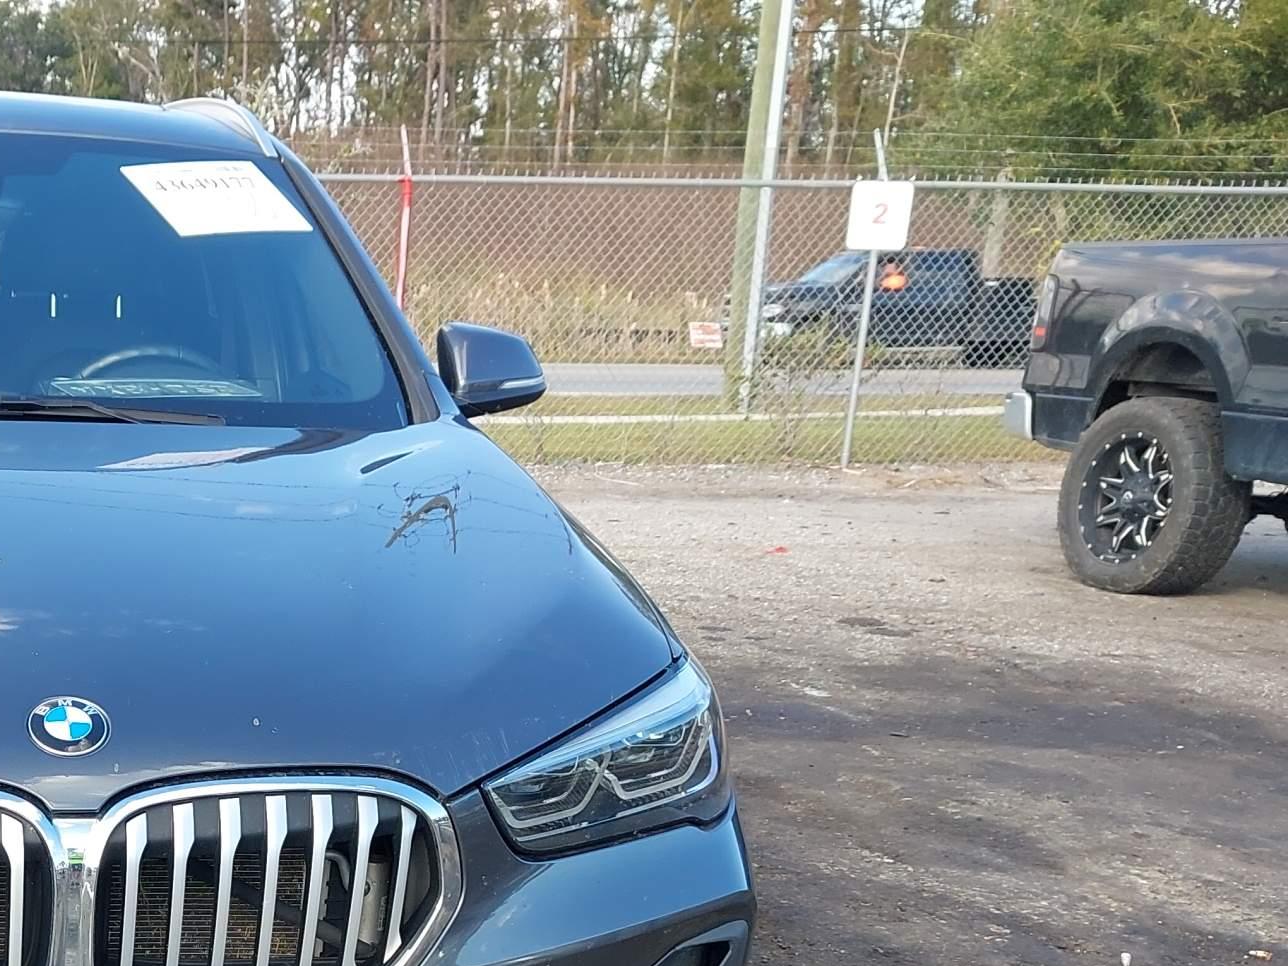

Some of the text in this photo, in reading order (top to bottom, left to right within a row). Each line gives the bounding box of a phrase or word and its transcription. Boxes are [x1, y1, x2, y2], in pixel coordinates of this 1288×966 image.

[154, 176, 256, 191] 43649177
[872, 203, 889, 224] 2
[34, 699, 99, 715] BMW
